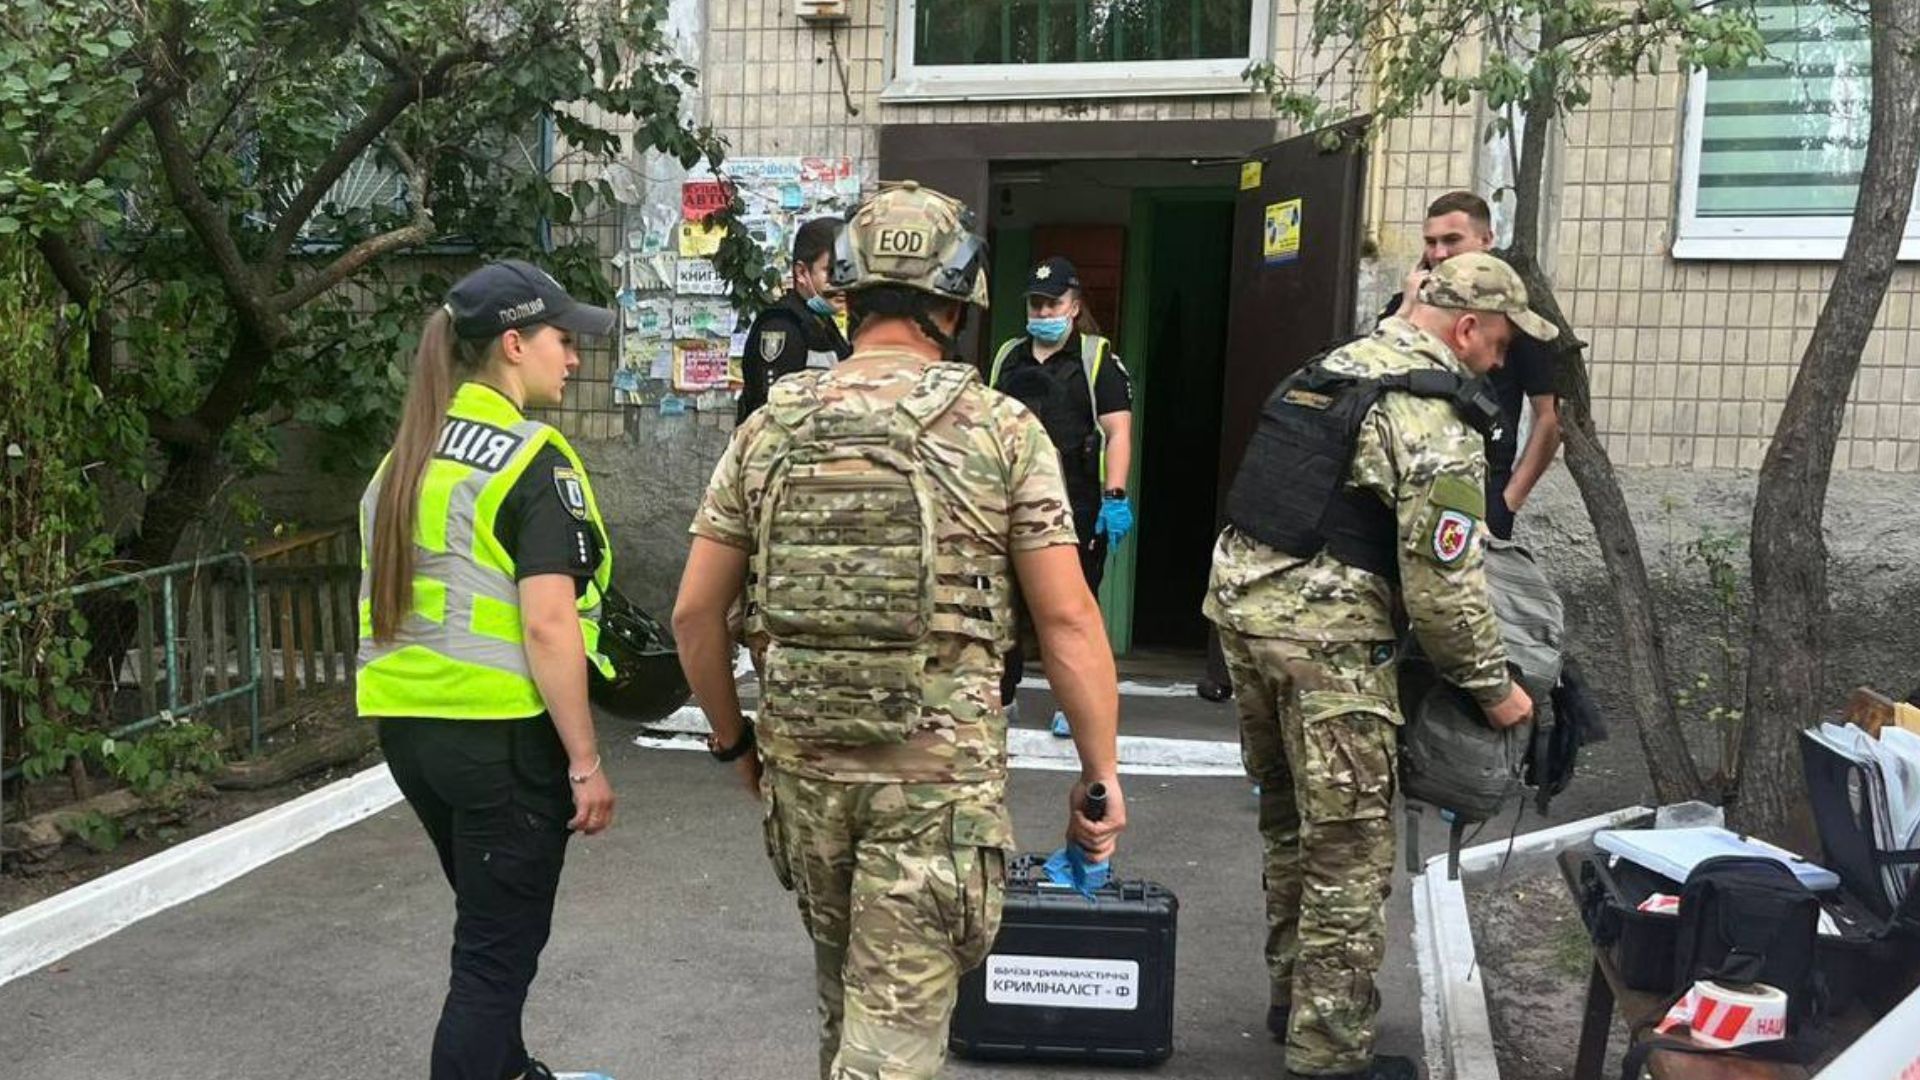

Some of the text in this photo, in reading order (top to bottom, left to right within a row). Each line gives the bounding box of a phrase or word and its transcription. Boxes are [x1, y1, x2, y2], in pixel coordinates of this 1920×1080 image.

[880, 229, 924, 253] EOD
[993, 979, 1102, 996] КРИМІНАЛІСТ
[1115, 985, 1130, 997] Ф
